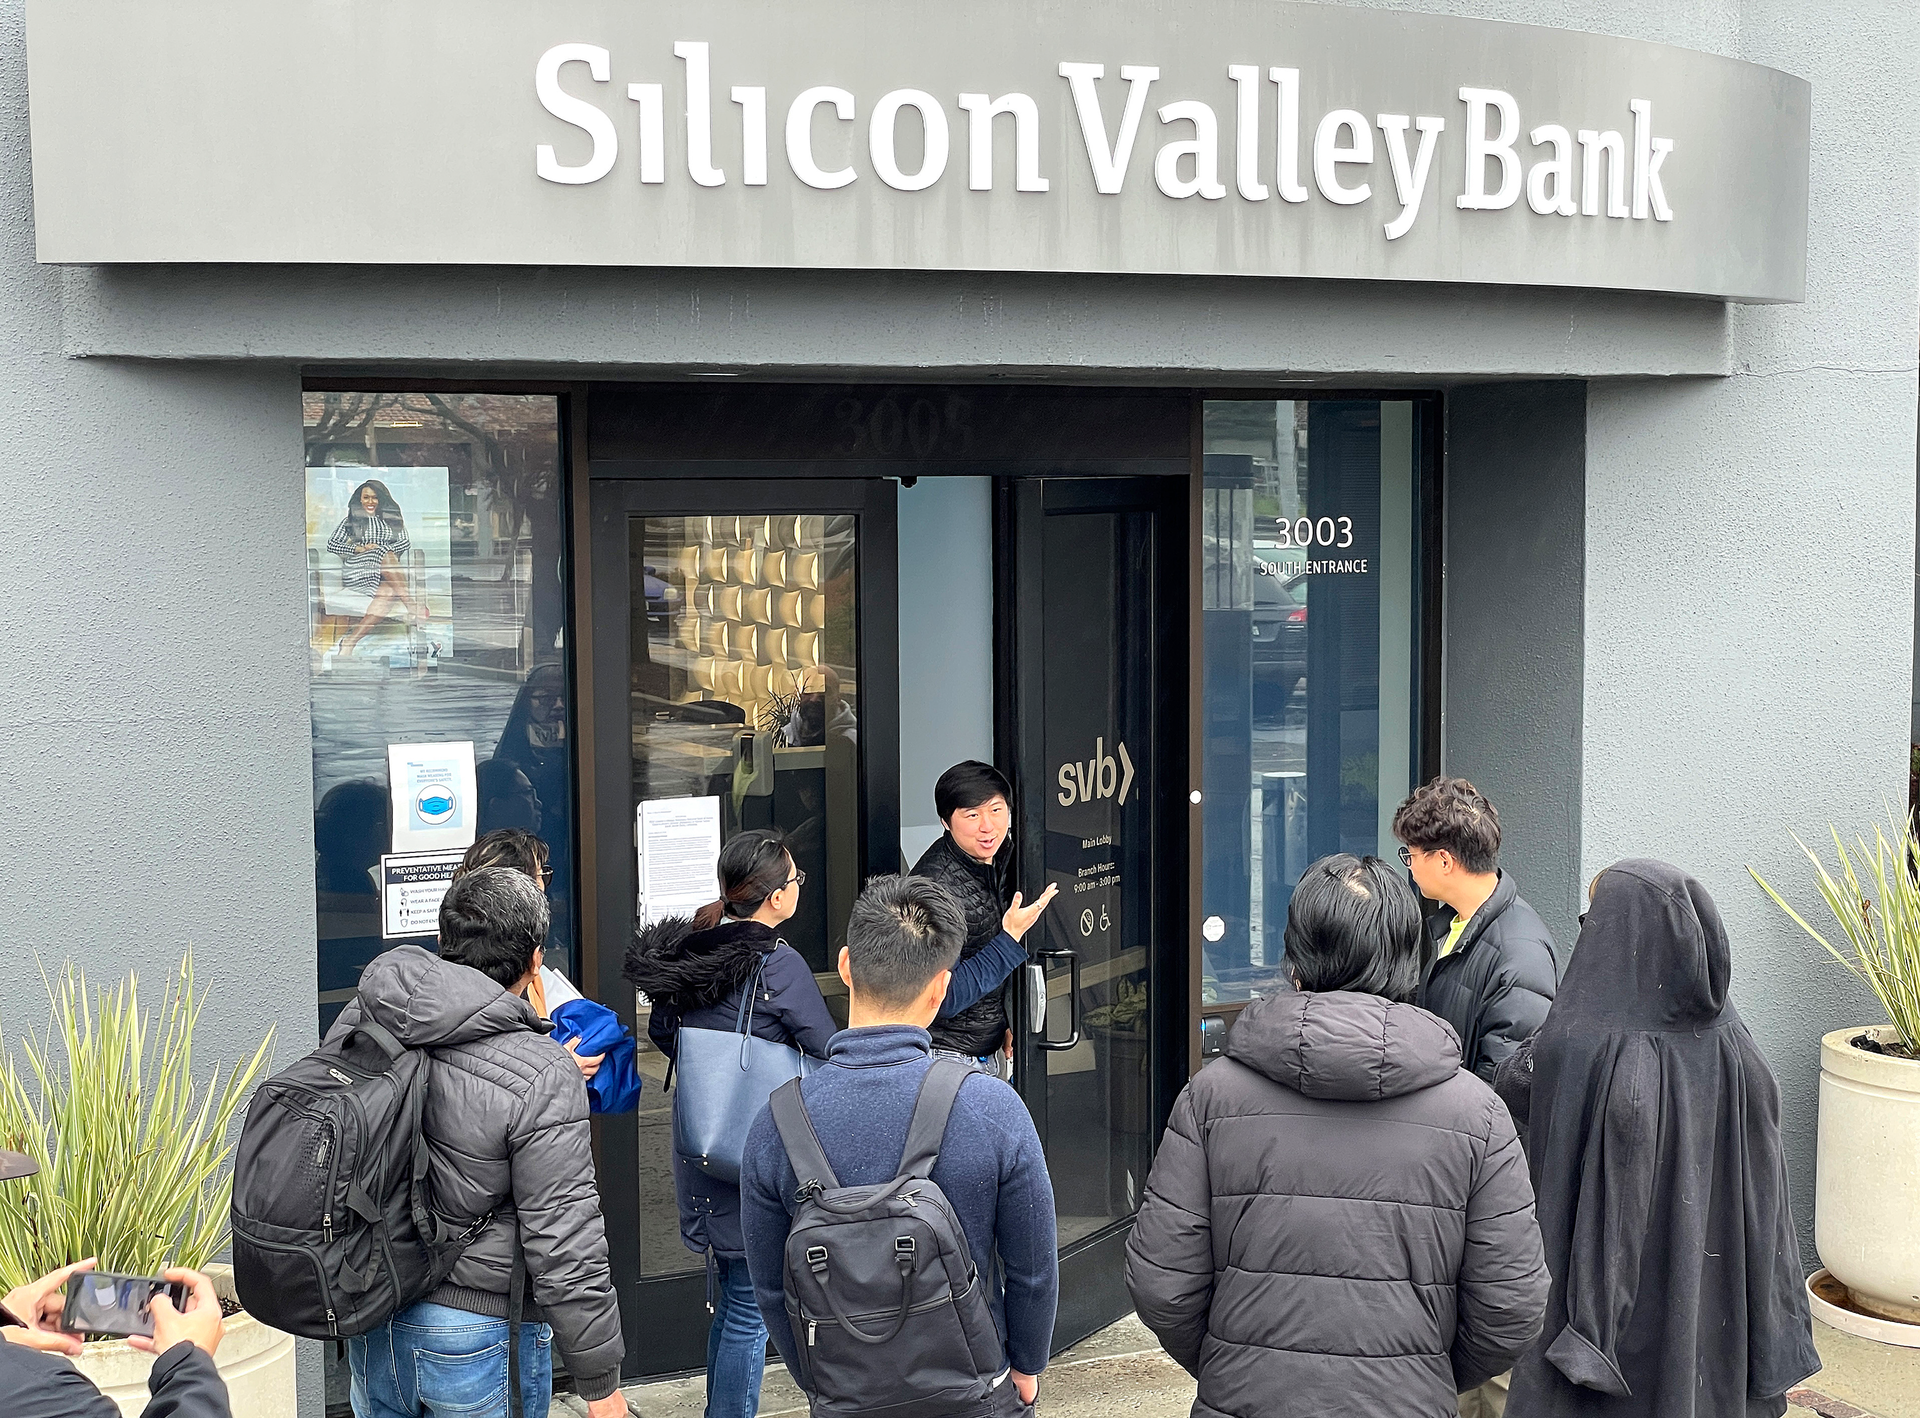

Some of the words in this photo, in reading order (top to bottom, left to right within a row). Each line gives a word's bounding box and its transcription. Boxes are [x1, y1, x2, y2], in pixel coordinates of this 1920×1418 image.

[535, 41, 1050, 192] Silicon
[1058, 61, 1445, 241] Valley
[1456, 86, 1674, 222] Bank
[1275, 516, 1354, 549] 3003
[1260, 561, 1301, 576] SOUTH
[1305, 559, 1368, 574] ENTRANCE
[1058, 736, 1117, 807] svb
[1082, 838, 1096, 849] Main
[1096, 834, 1112, 846] Lobby
[391, 865, 442, 875] PREVENTATIVE
[1078, 865, 1097, 878] Branch
[1073, 882, 1087, 894] 9:00
[1087, 881, 1096, 890] am
[1099, 875, 1111, 887] 3:00
[1111, 875, 1121, 886] pm
